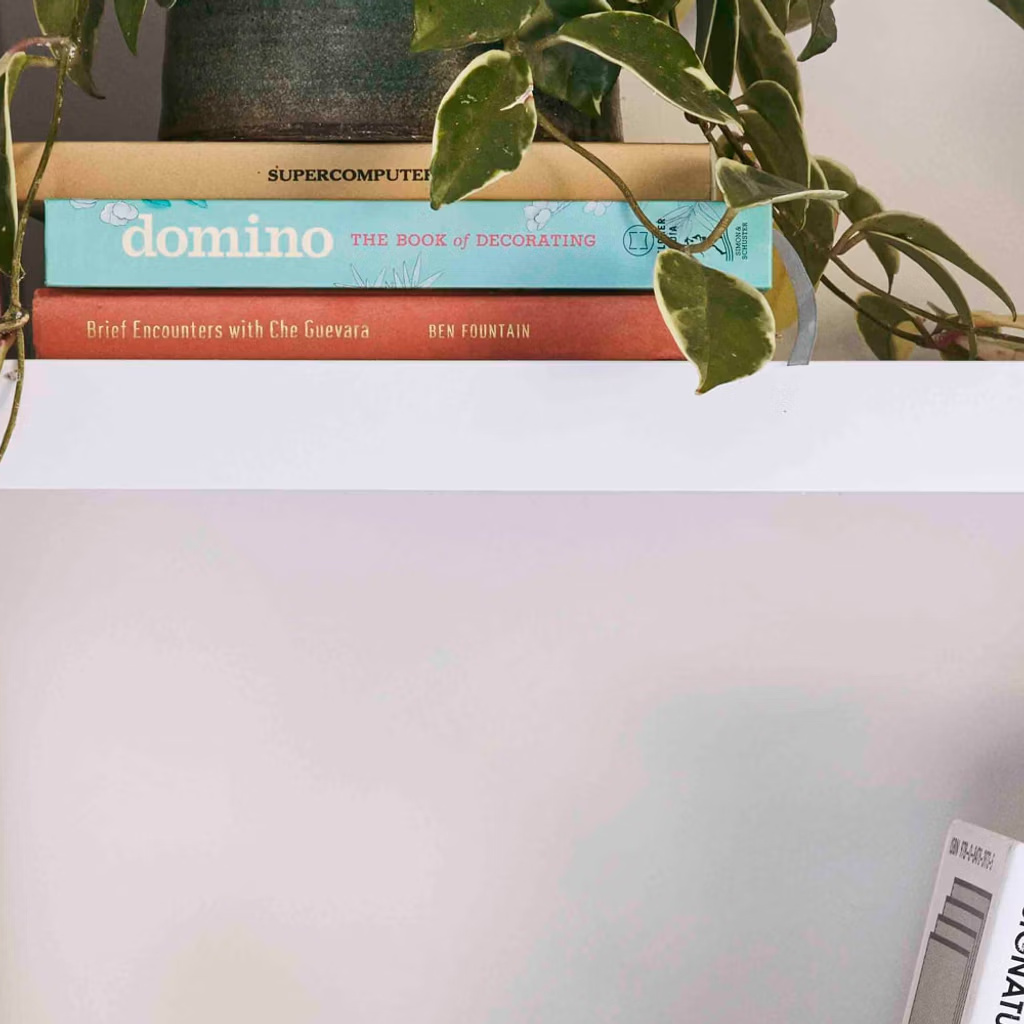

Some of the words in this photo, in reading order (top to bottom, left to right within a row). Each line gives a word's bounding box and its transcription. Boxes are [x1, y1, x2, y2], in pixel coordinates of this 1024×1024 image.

[122, 213, 334, 259] domino
[351, 233, 388, 247] THE
[396, 233, 448, 247] BOOK
[453, 232, 471, 249] of
[476, 233, 597, 247] DECORATING
[86, 319, 127, 338] Brief
[132, 319, 223, 338] Encounters
[229, 319, 263, 338] with
[269, 319, 299, 338] Che
[304, 319, 370, 338] Guevara
[428, 323, 455, 339] BEN
[461, 323, 531, 339] FOUNTAIN
